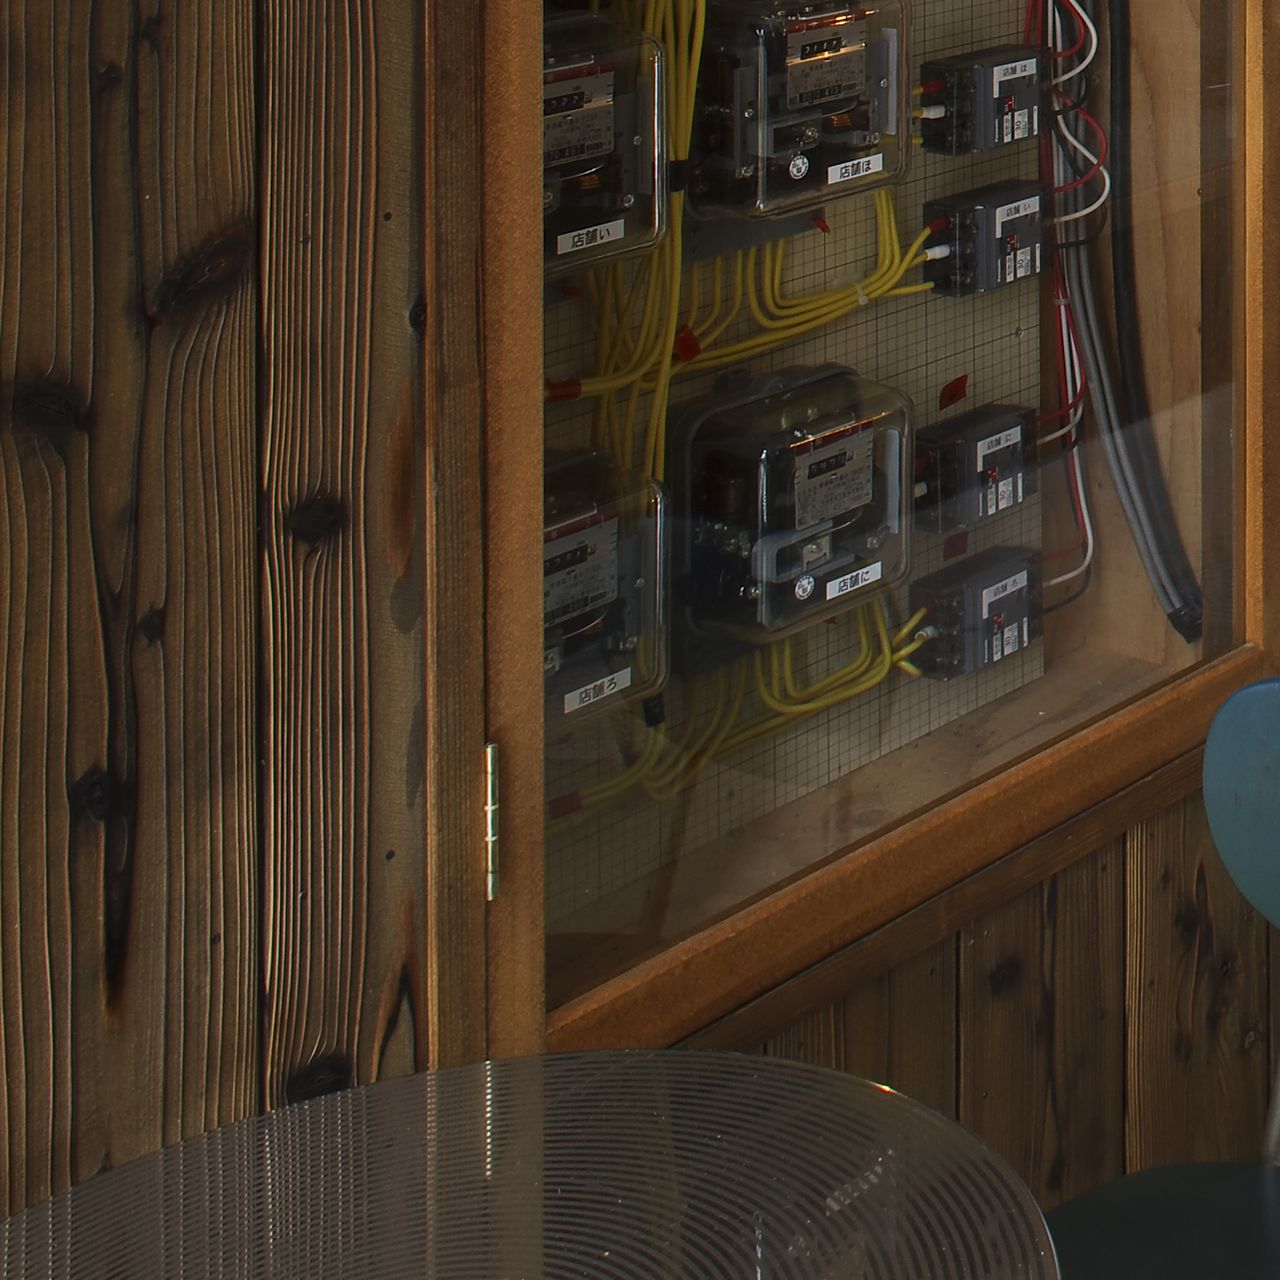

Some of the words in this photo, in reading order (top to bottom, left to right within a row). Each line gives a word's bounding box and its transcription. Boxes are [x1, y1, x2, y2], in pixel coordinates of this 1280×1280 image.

[571, 227, 611, 249] 店舗い
[838, 571, 870, 593] 店舗に
[577, 677, 617, 705] 店舗ろ
